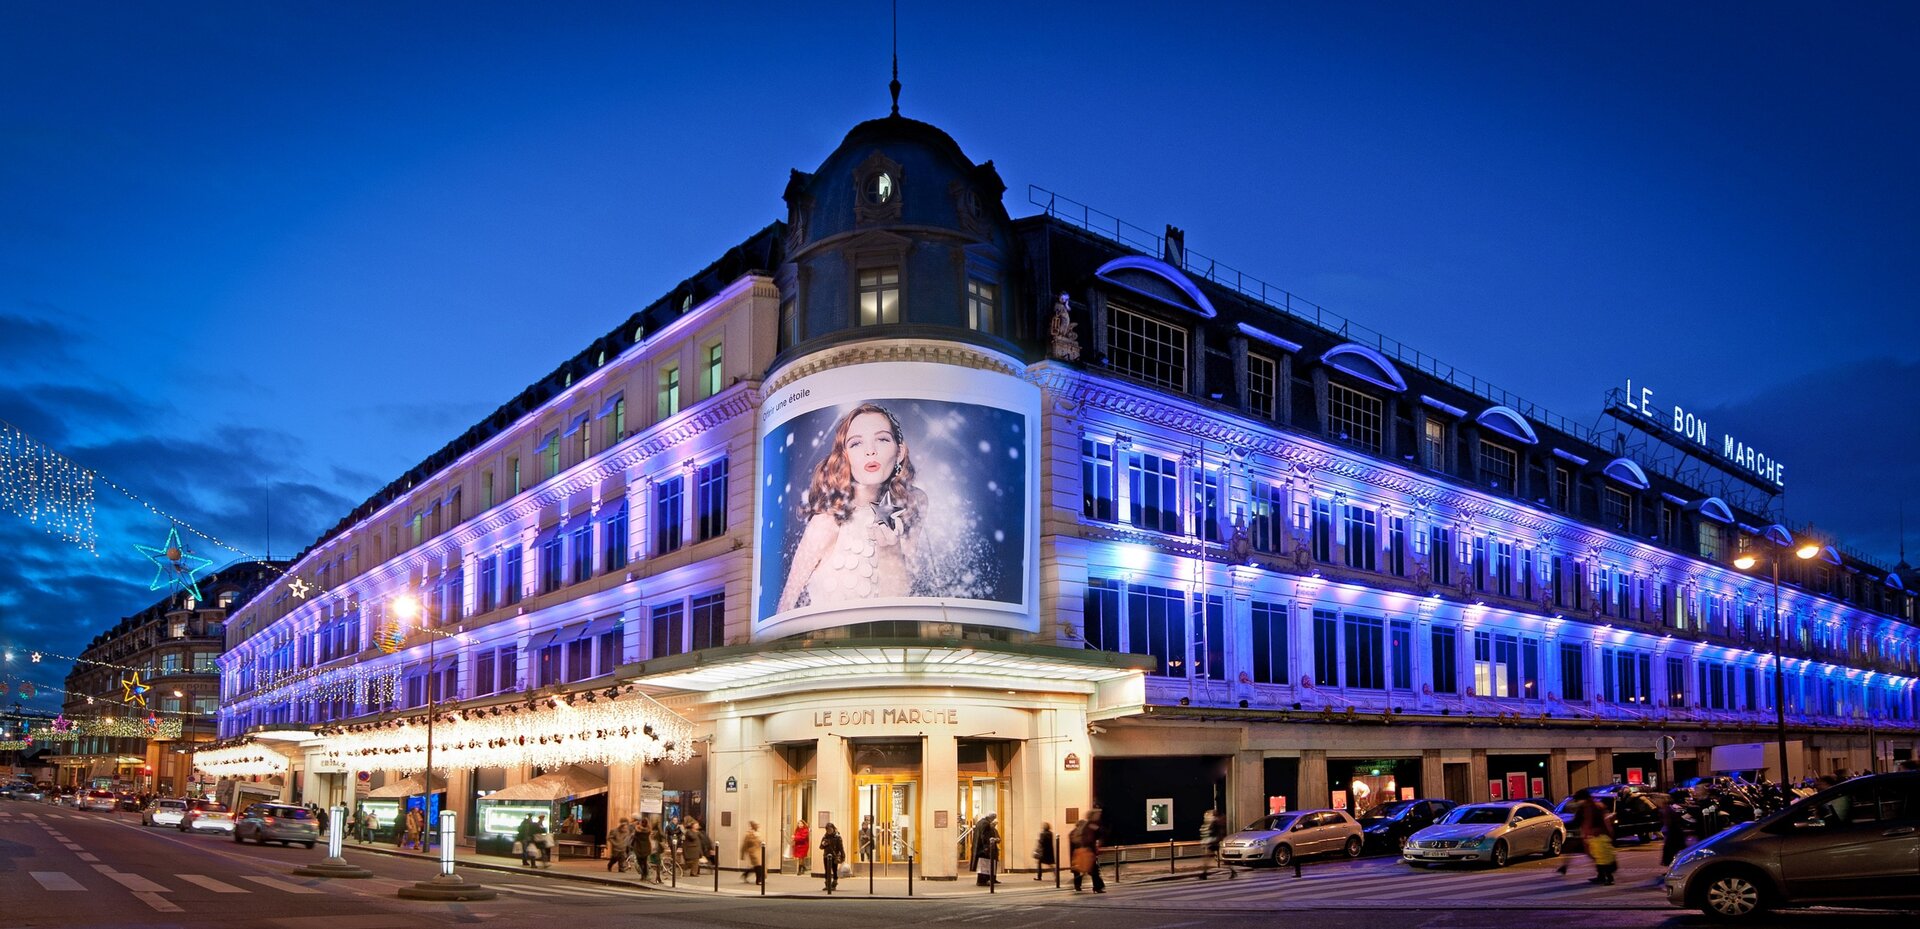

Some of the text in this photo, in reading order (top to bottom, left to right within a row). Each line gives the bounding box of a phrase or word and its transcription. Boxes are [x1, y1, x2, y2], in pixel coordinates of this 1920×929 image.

[775, 399, 787, 411] une
[788, 389, 811, 404] étoile
[1626, 378, 1784, 487] LE BON MARCHE
[814, 708, 958, 727] LE BON MARCHE
